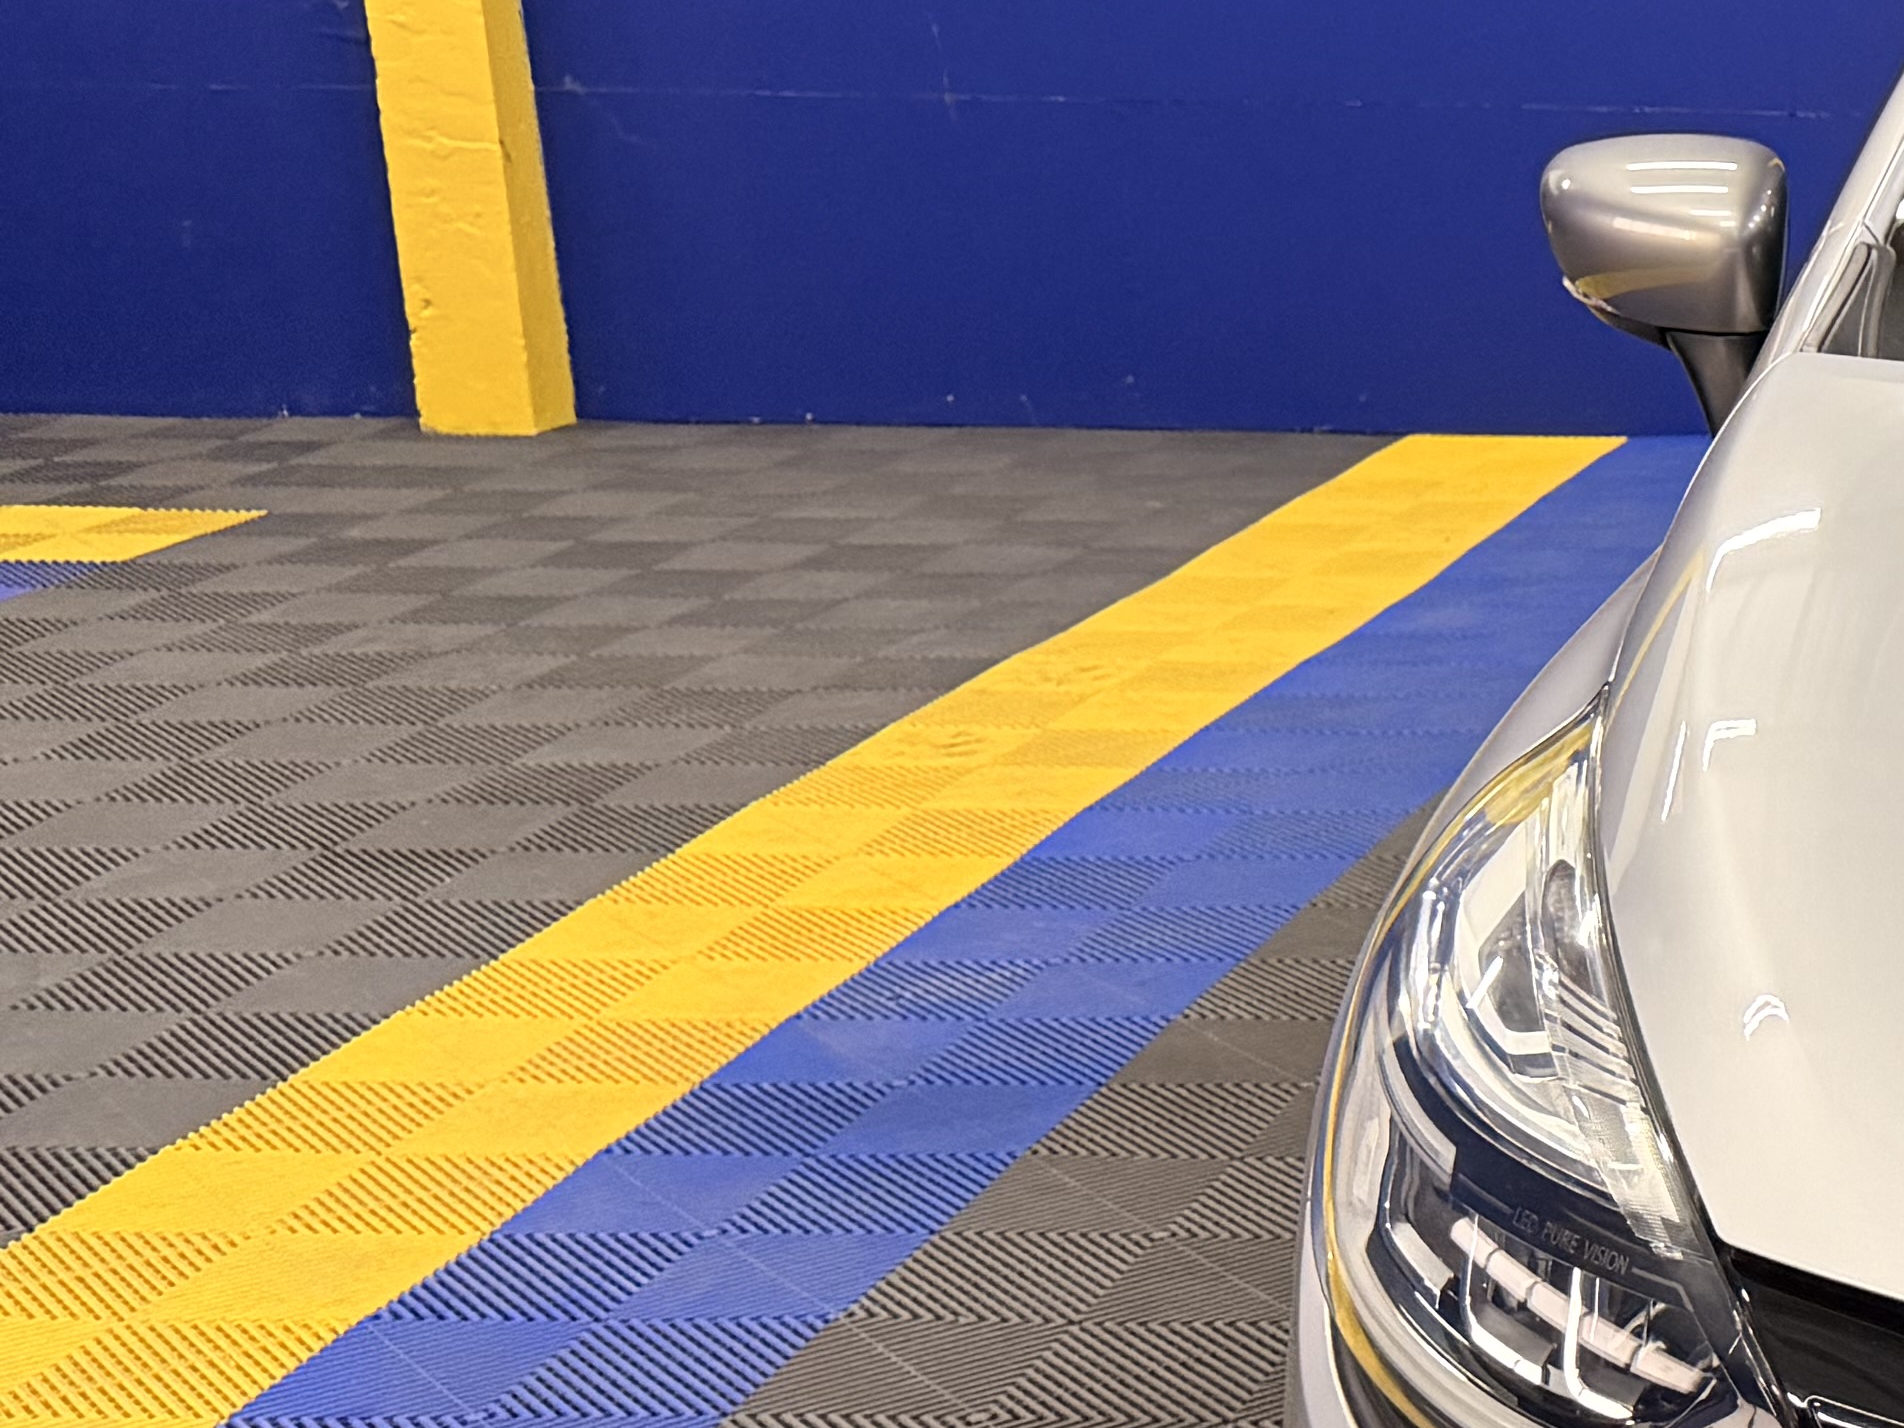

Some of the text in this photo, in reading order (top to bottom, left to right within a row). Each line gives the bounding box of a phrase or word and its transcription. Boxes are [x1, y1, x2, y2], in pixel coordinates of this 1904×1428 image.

[1512, 1206, 1630, 1276] LED PURE VISION
